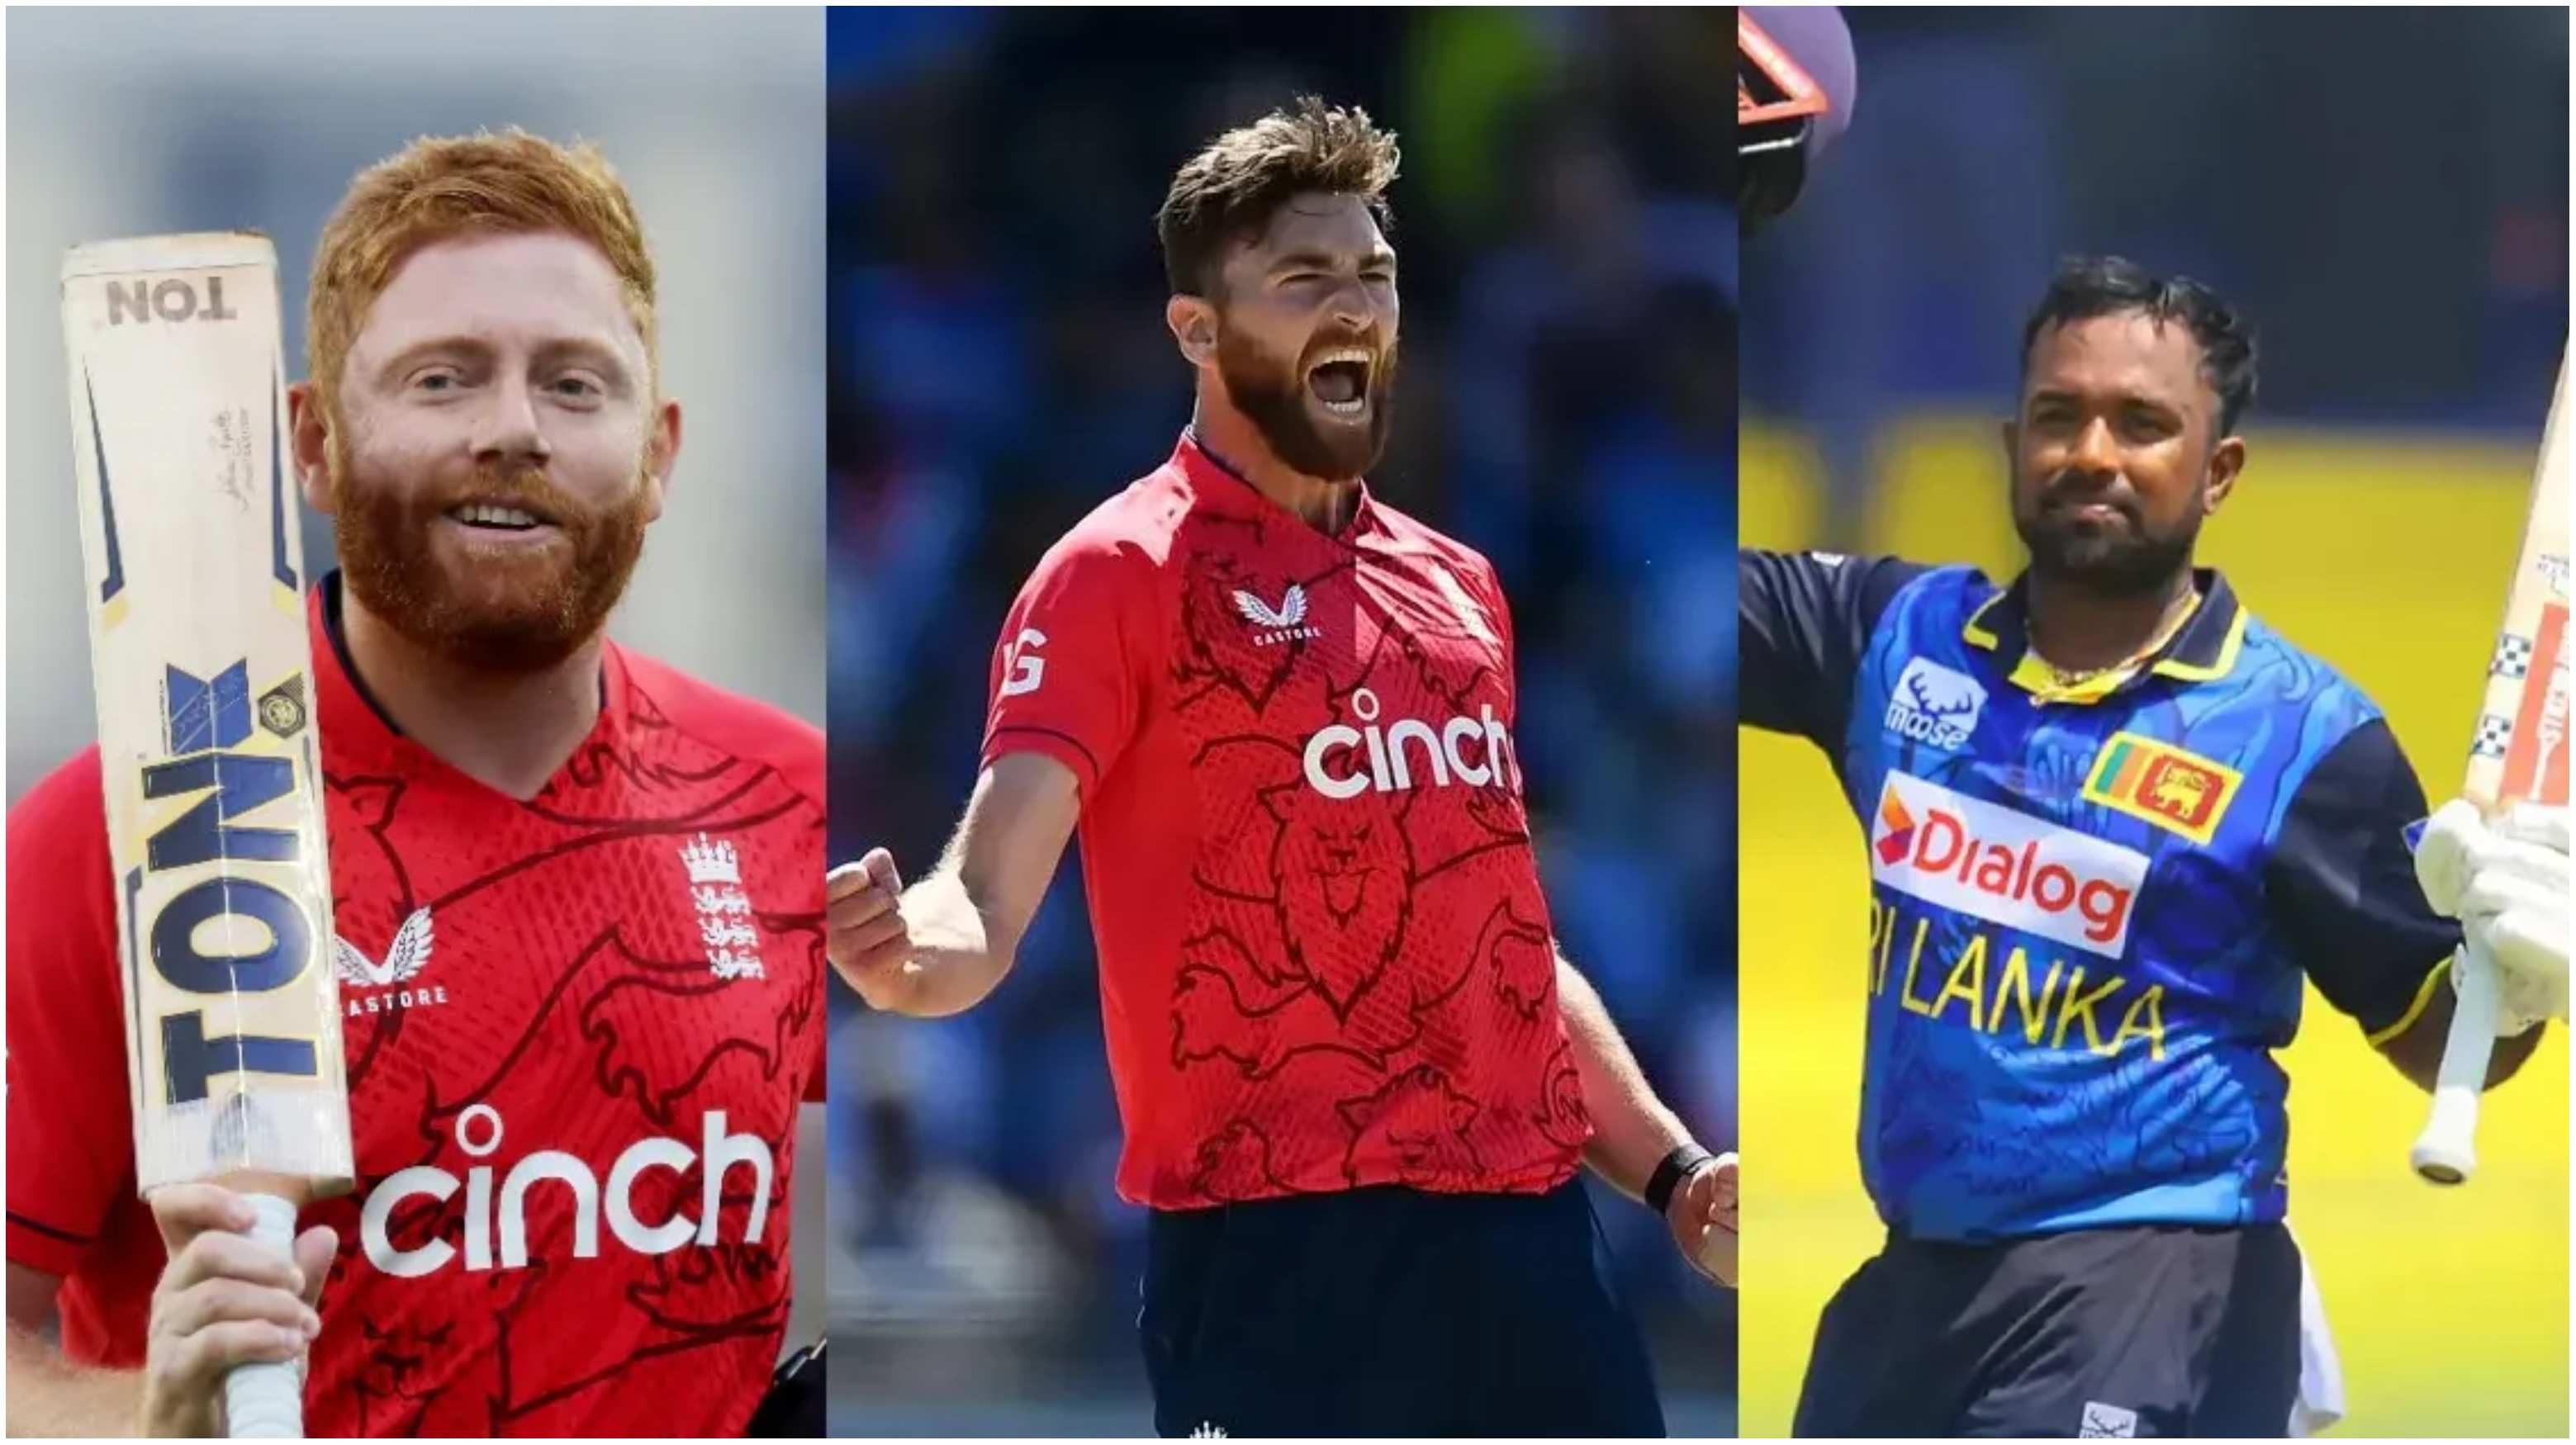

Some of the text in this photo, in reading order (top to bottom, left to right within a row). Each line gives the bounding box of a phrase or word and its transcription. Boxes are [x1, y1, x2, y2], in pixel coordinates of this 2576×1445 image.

[107, 277, 237, 326] TON
[1304, 688, 1522, 799] cinch
[1885, 704, 1968, 751] moose
[141, 748, 318, 1105] TON
[1912, 808, 2131, 942] Dialog
[341, 986, 448, 1017] ASTORE
[1902, 917, 2166, 1061] LANKA
[359, 1103, 774, 1278] cinch
